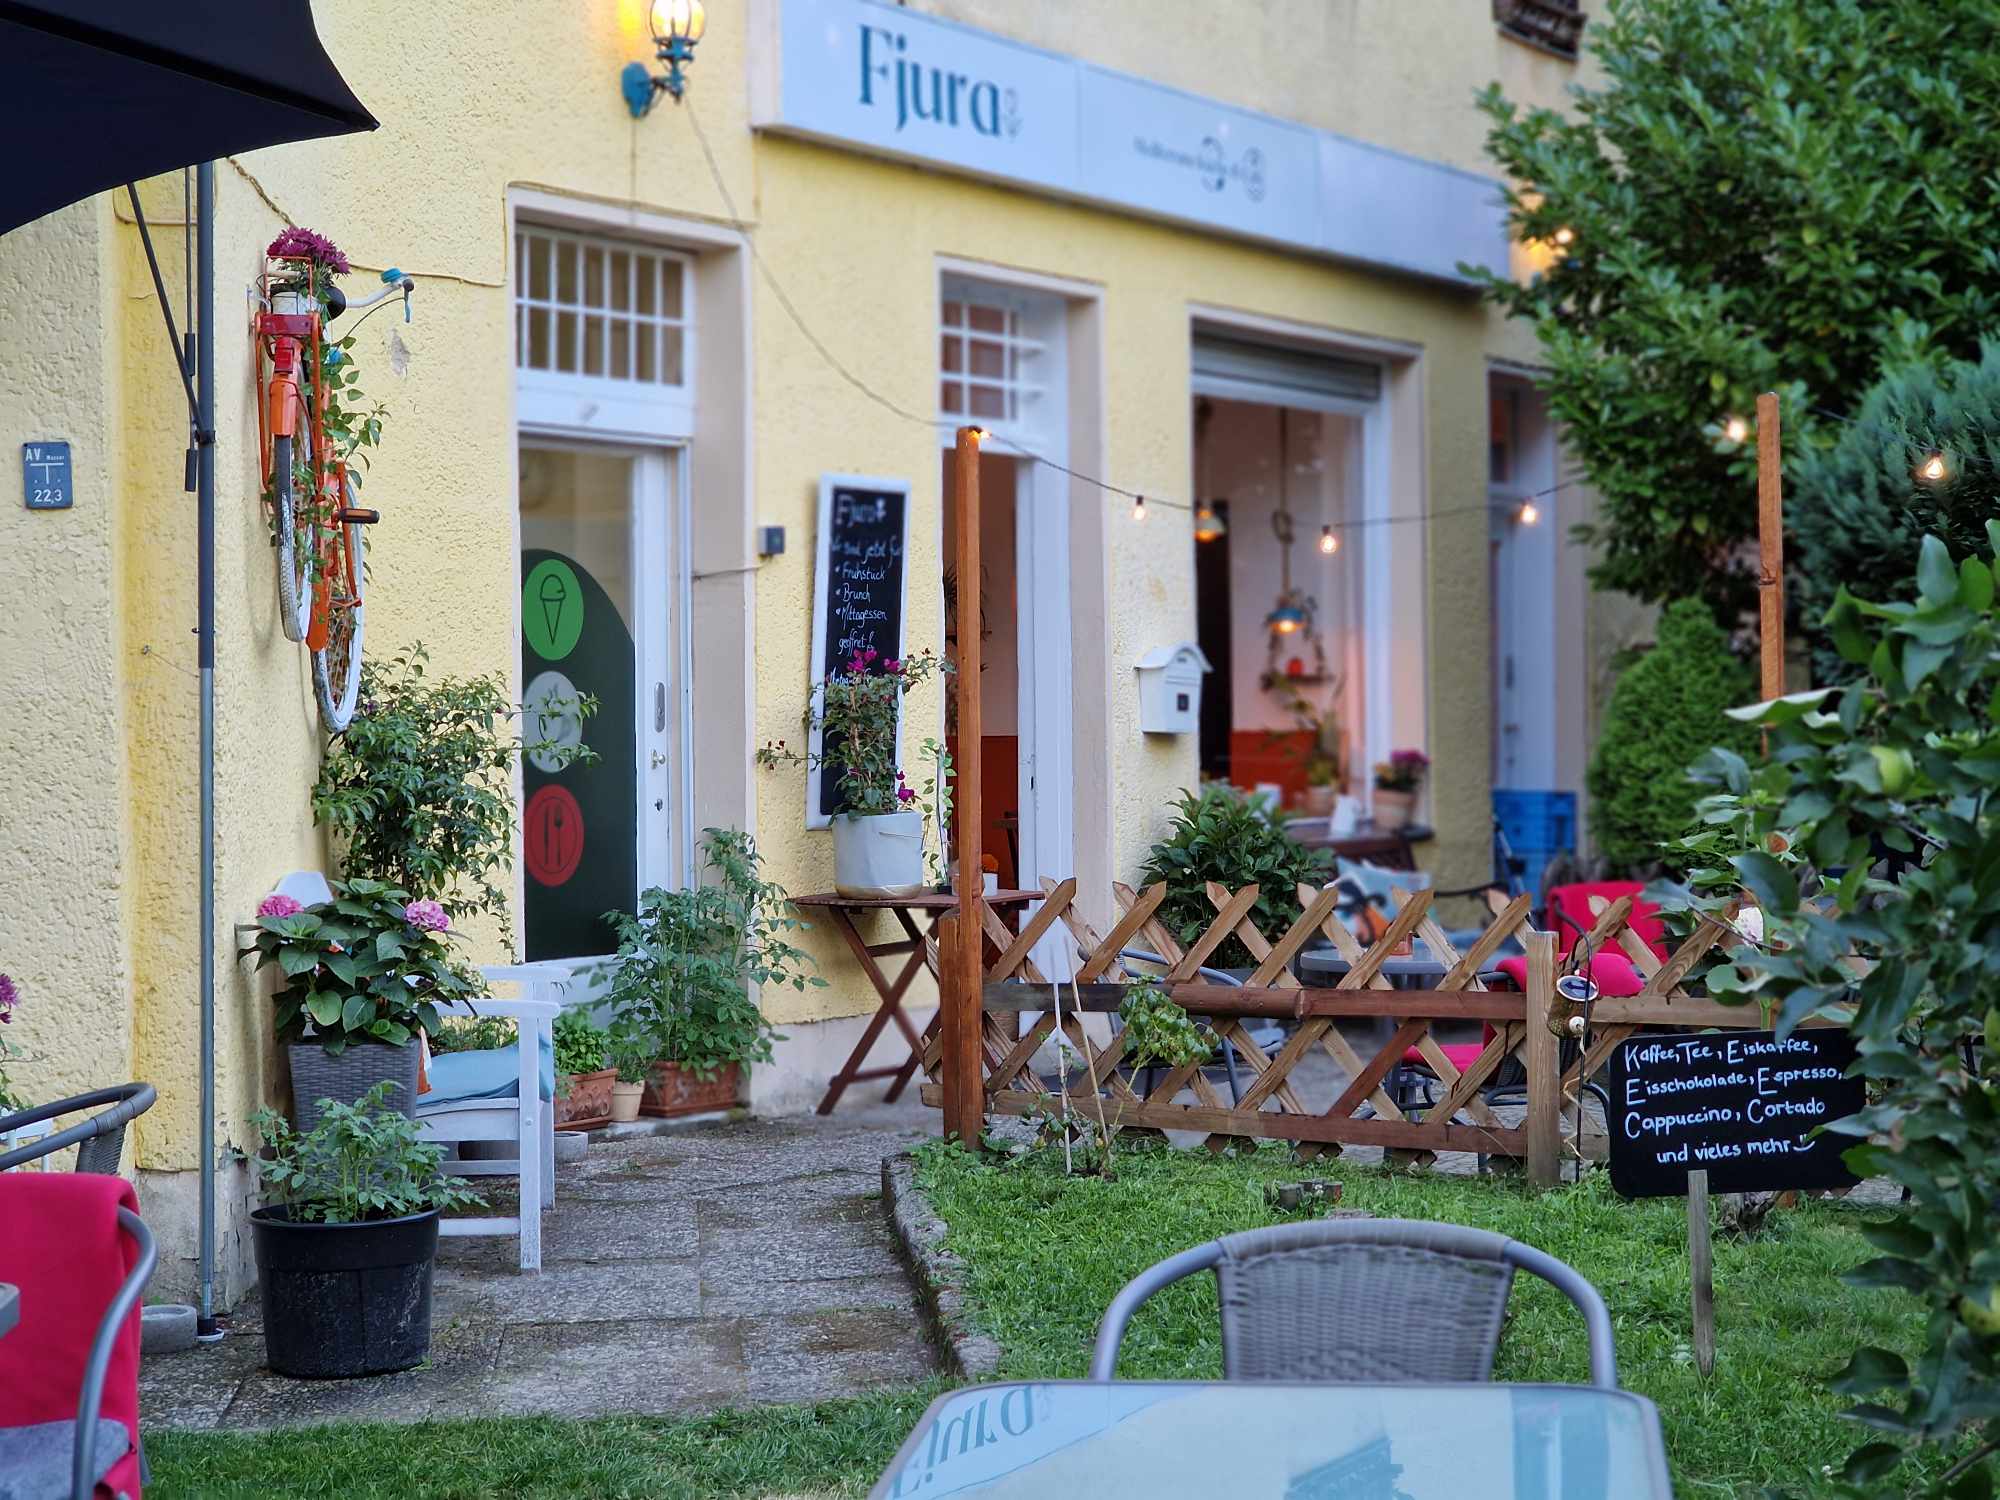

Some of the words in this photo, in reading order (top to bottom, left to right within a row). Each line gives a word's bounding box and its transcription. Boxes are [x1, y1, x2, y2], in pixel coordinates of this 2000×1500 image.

[859, 23, 1001, 137] Fjura
[25, 447, 41, 461] AV
[33, 488, 63, 504] 22,3
[842, 582, 871, 604] Brunch
[841, 602, 888, 630] Mittagessen
[1626, 1072, 1755, 1106] Eisschokolade,
[1758, 1067, 1843, 1095] Espresso,
[1625, 1107, 1741, 1139] Cappuccino,
[1747, 1097, 1826, 1124] Cortado
[1656, 1142, 1689, 1164] und
[1694, 1140, 1742, 1161] vieles
[1747, 1137, 1792, 1155] mehr
